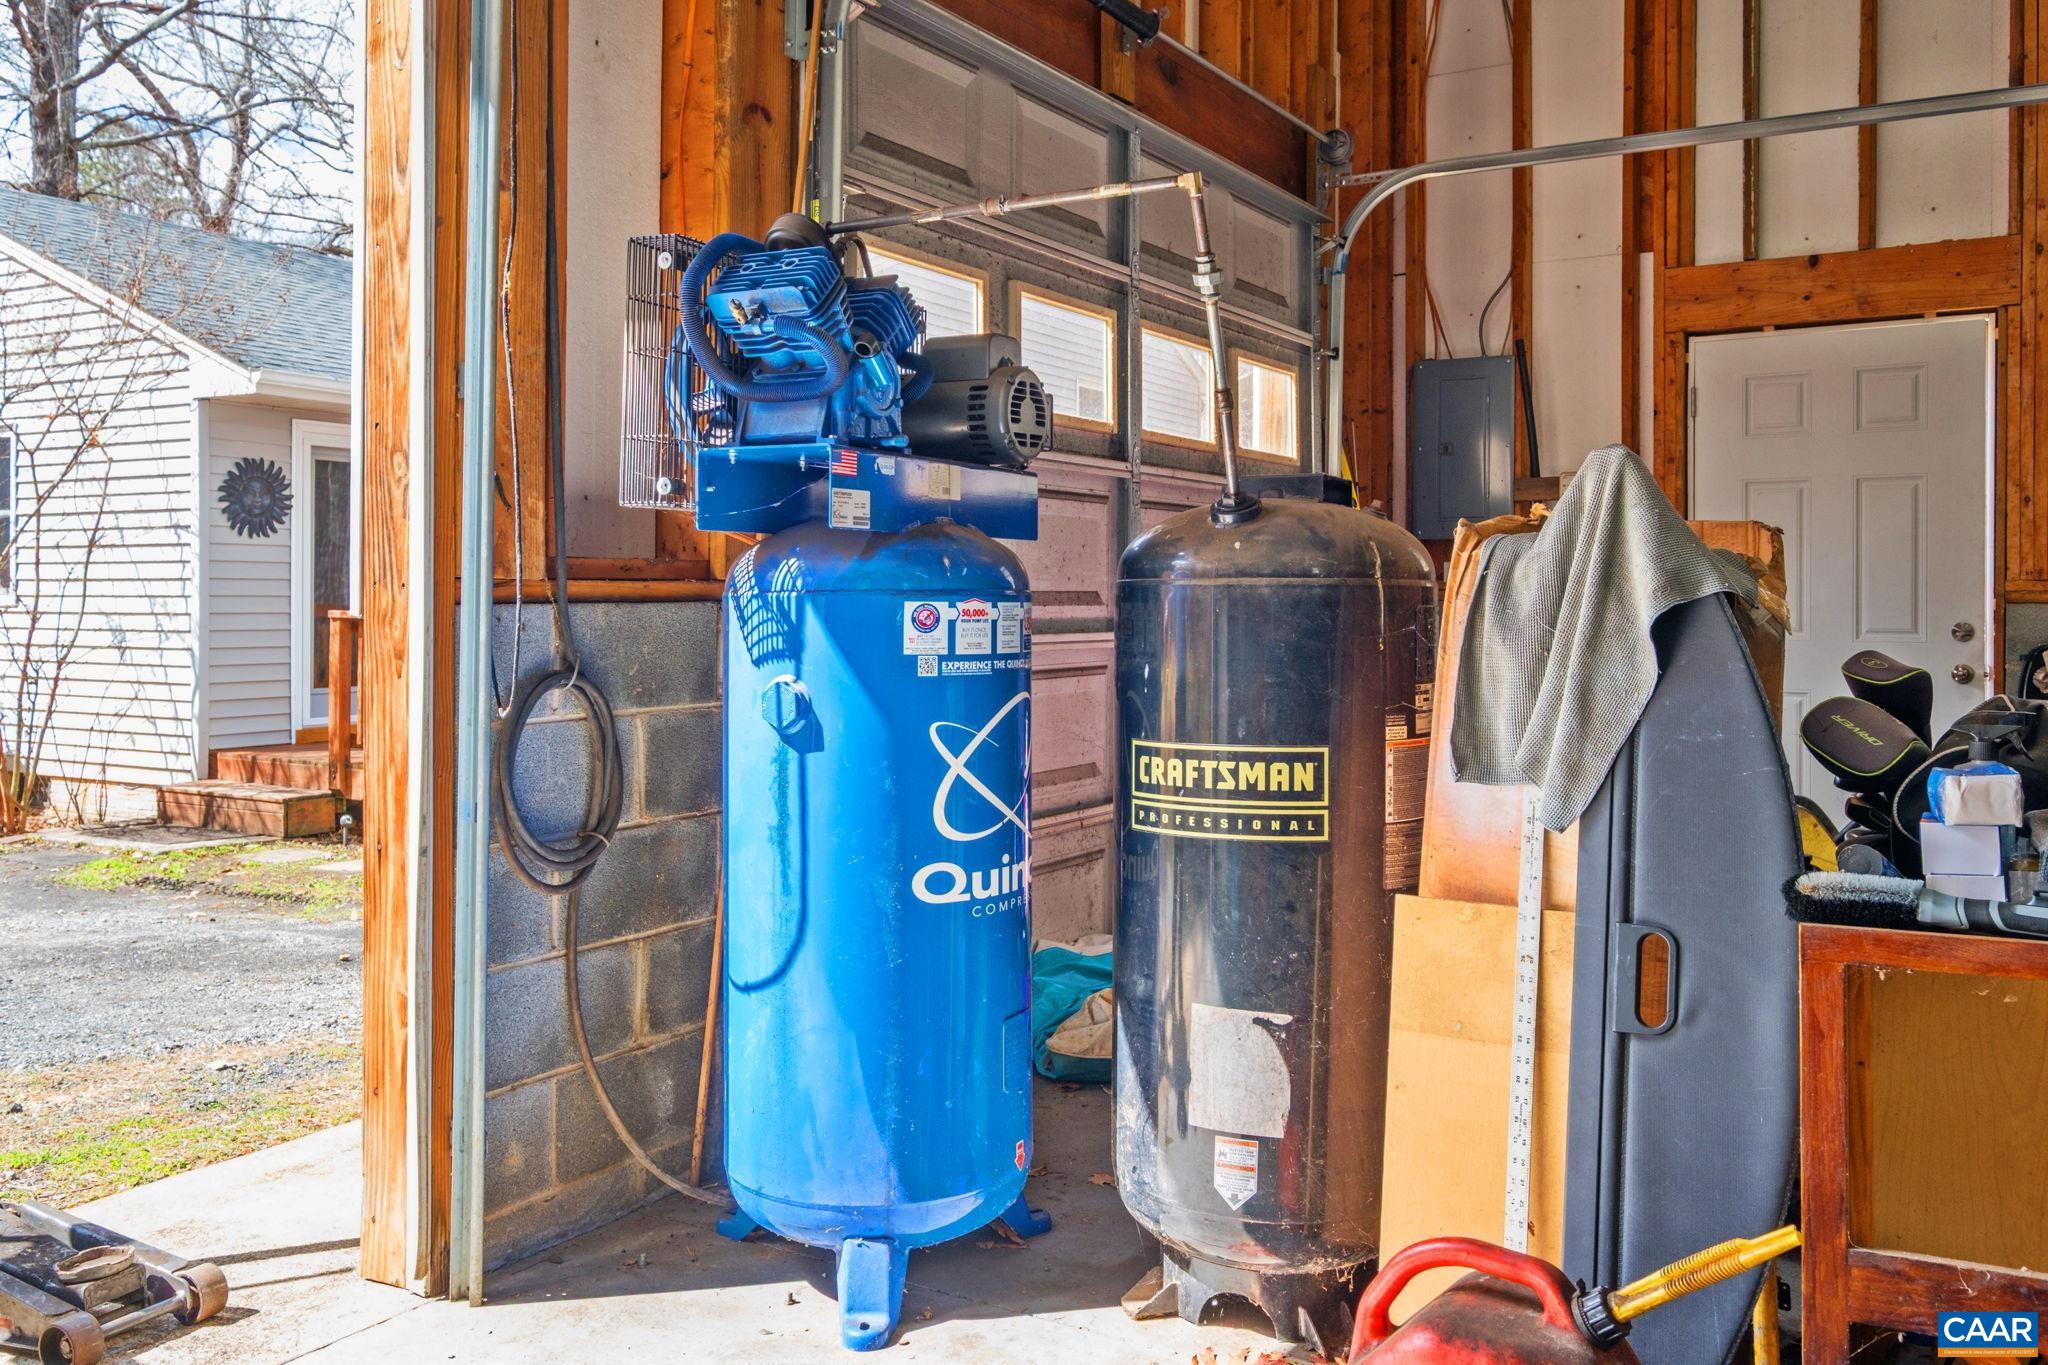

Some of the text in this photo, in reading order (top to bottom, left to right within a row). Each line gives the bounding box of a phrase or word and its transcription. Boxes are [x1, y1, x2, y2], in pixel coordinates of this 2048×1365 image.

[961, 608, 989, 619] 50,000+
[942, 660, 992, 670] EXPERIENCE
[993, 660, 1006, 669] THE
[1830, 715, 1883, 745] DRIVER
[1138, 755, 1315, 792] CRAFTSMAN
[1138, 810, 1316, 831] PROFESSIONAL
